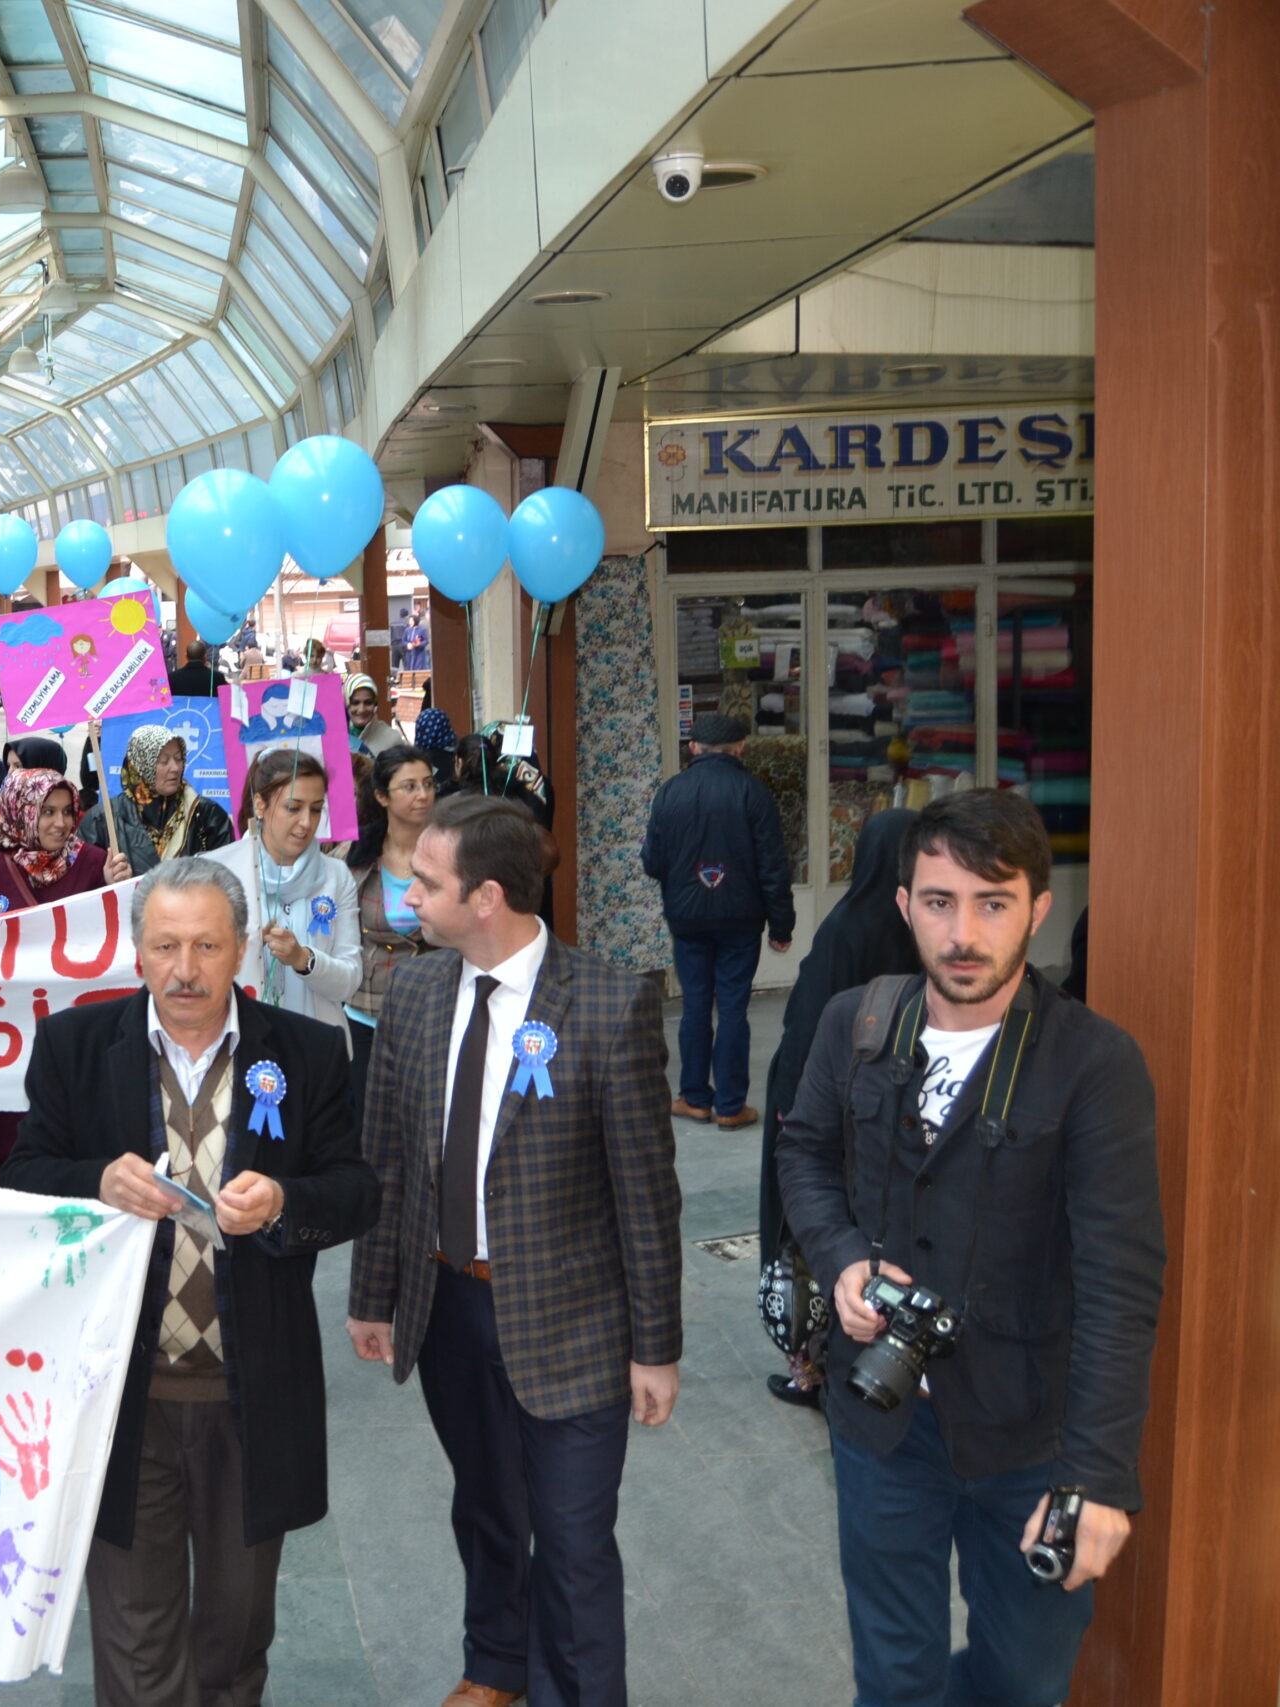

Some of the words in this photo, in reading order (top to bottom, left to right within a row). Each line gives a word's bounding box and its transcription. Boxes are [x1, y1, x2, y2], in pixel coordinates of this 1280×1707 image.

[958, 481, 1021, 506] LTD.
[48, 670, 61, 689] AMA
[92, 692, 113, 714] BENDE
